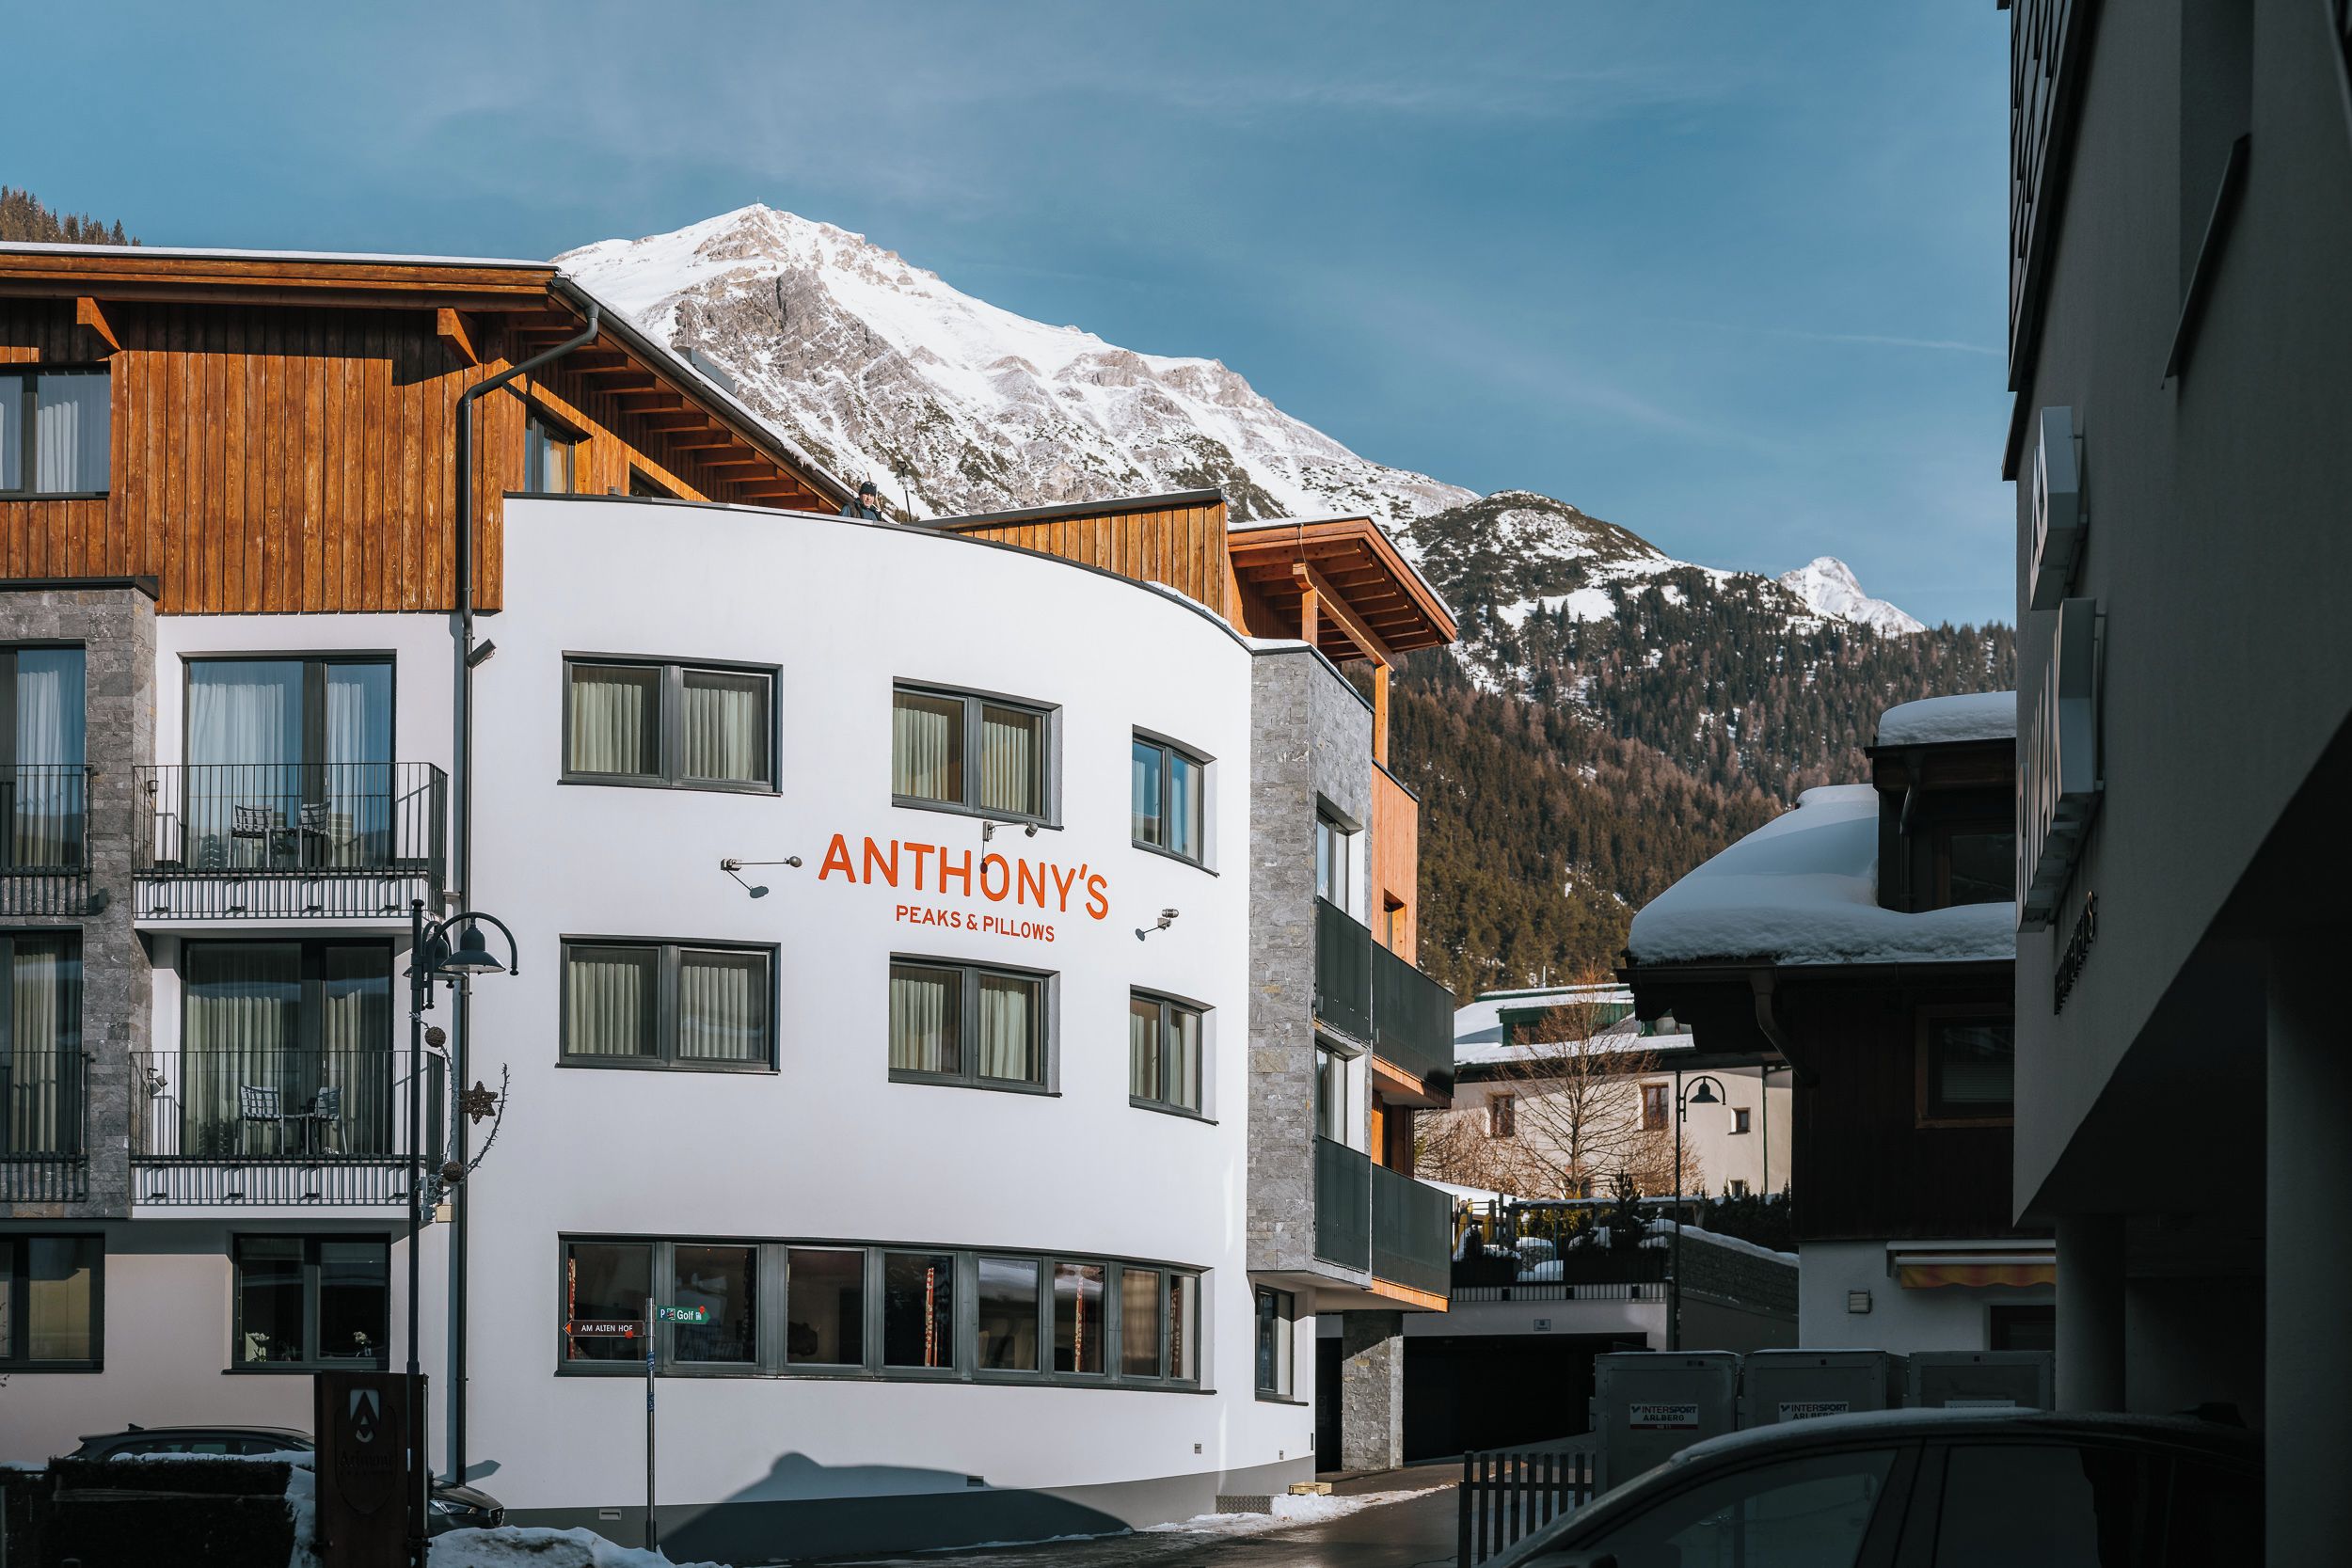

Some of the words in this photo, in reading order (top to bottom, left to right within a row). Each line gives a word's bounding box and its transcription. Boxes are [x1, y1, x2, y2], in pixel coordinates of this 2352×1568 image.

[818, 833, 1109, 920] ANTHONY'S
[896, 904, 961, 927] PEAKS
[966, 913, 978, 930] &
[983, 915, 1056, 942] PILLOWS
[676, 1309, 694, 1321] Golf
[1641, 1405, 1697, 1414] INTERSPORT
[1790, 1403, 1848, 1413] INTERSPORT
